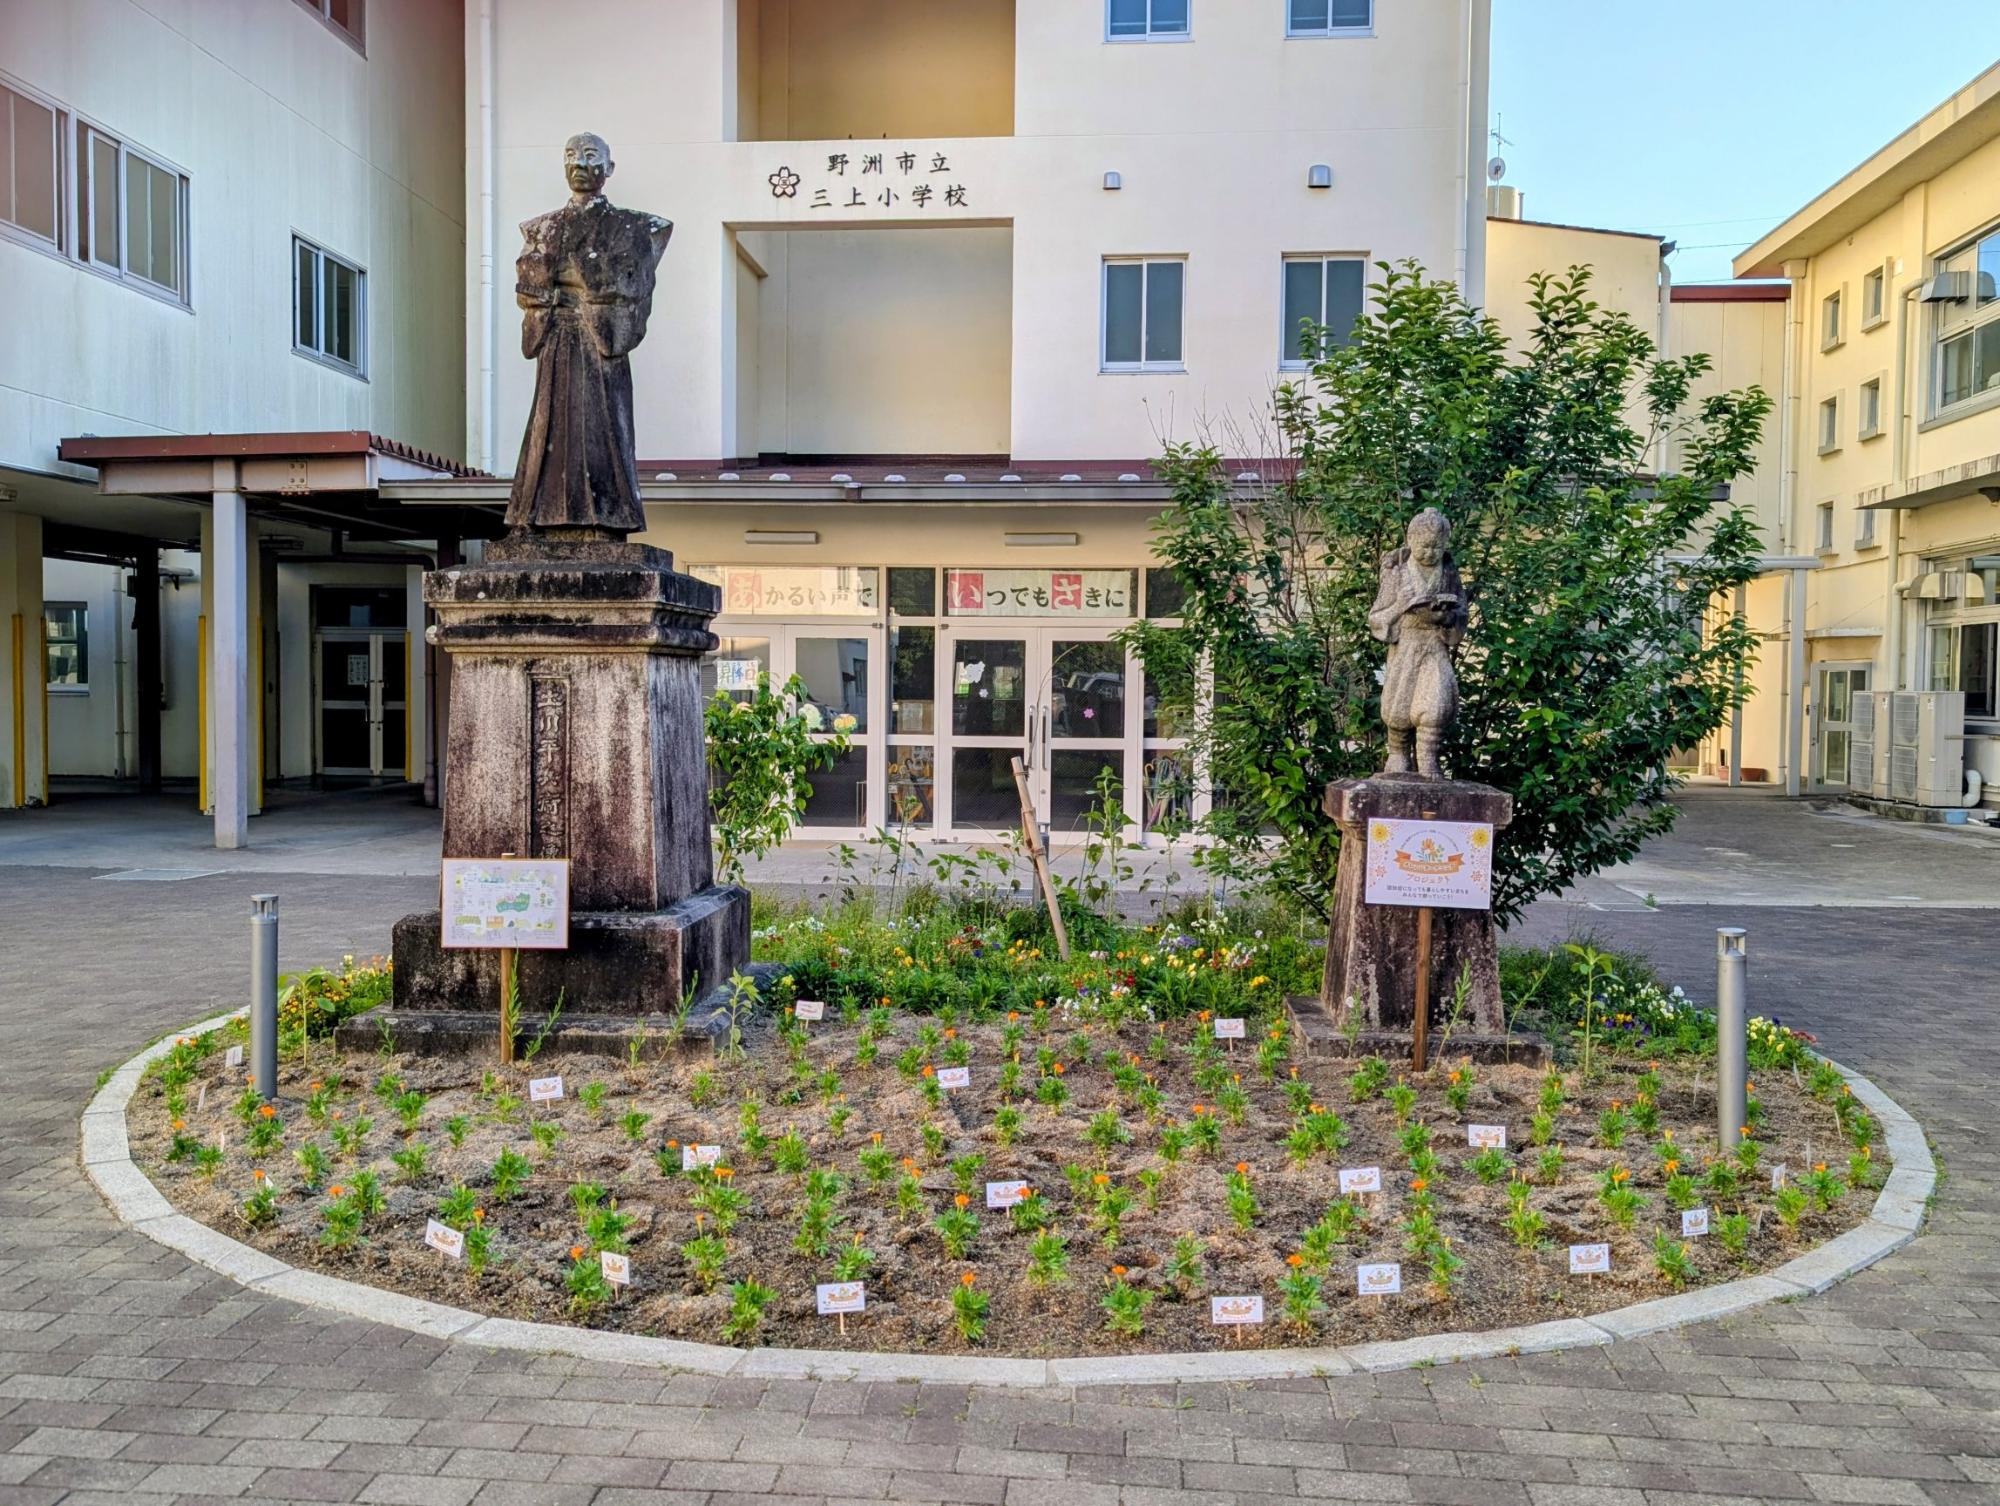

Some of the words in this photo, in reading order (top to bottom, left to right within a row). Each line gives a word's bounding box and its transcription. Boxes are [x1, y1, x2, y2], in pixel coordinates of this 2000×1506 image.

[826, 151, 951, 176] 野洲市立
[809, 183, 969, 209] 三上小学校
[950, 575, 1124, 610] いつでもさきに
